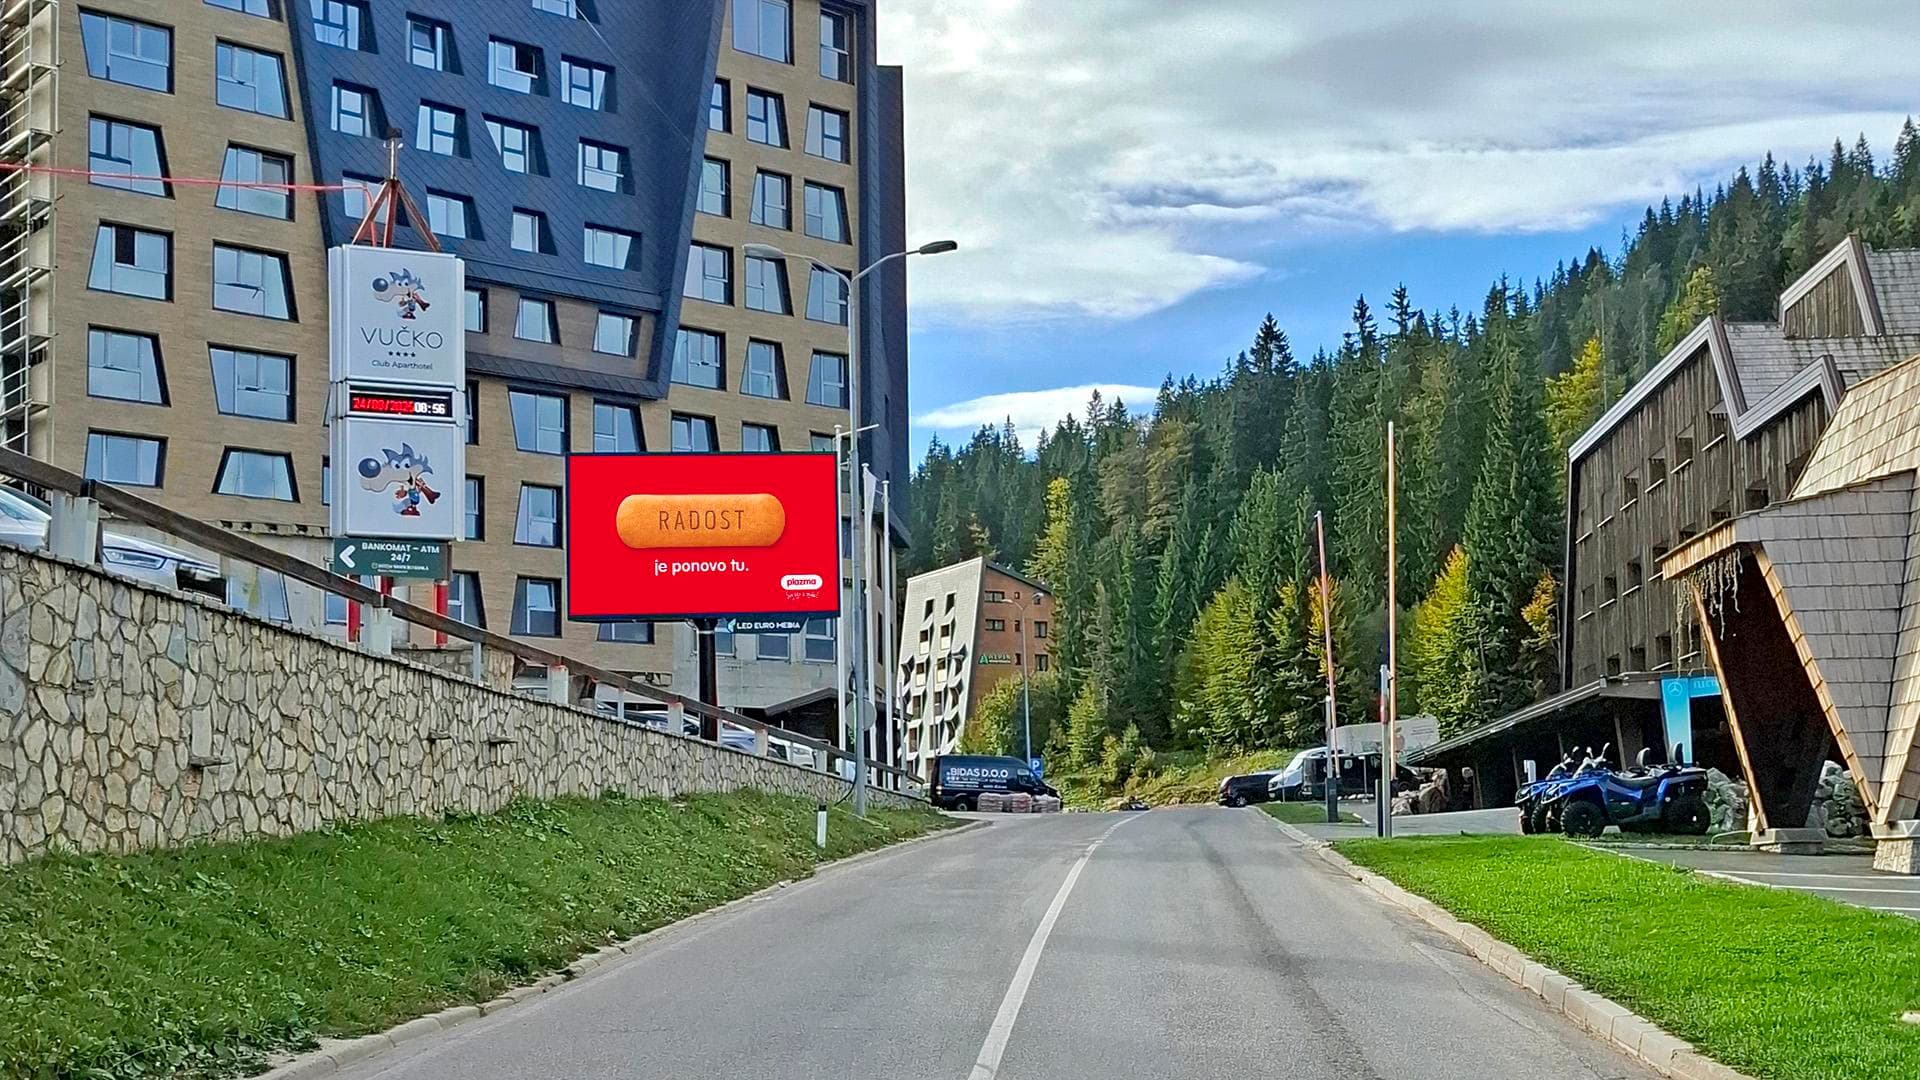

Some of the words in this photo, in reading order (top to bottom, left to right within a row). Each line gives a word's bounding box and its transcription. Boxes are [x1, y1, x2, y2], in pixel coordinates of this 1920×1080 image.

[361, 326, 443, 349] VUČKO
[371, 359, 391, 368] Club
[392, 360, 434, 370] Aparthotel
[414, 402, 445, 414] 08:56
[659, 509, 745, 530] RADOST
[361, 542, 411, 552] BANKOMAT
[420, 545, 440, 554] ATM
[390, 553, 412, 564] 24/7
[654, 559, 668, 576] je
[671, 560, 727, 577] ponovo
[730, 559, 749, 572] tu.
[787, 577, 817, 588] plazma
[753, 621, 776, 629] EURO
[776, 621, 801, 629] MEDIA
[1032, 760, 1040, 771] P
